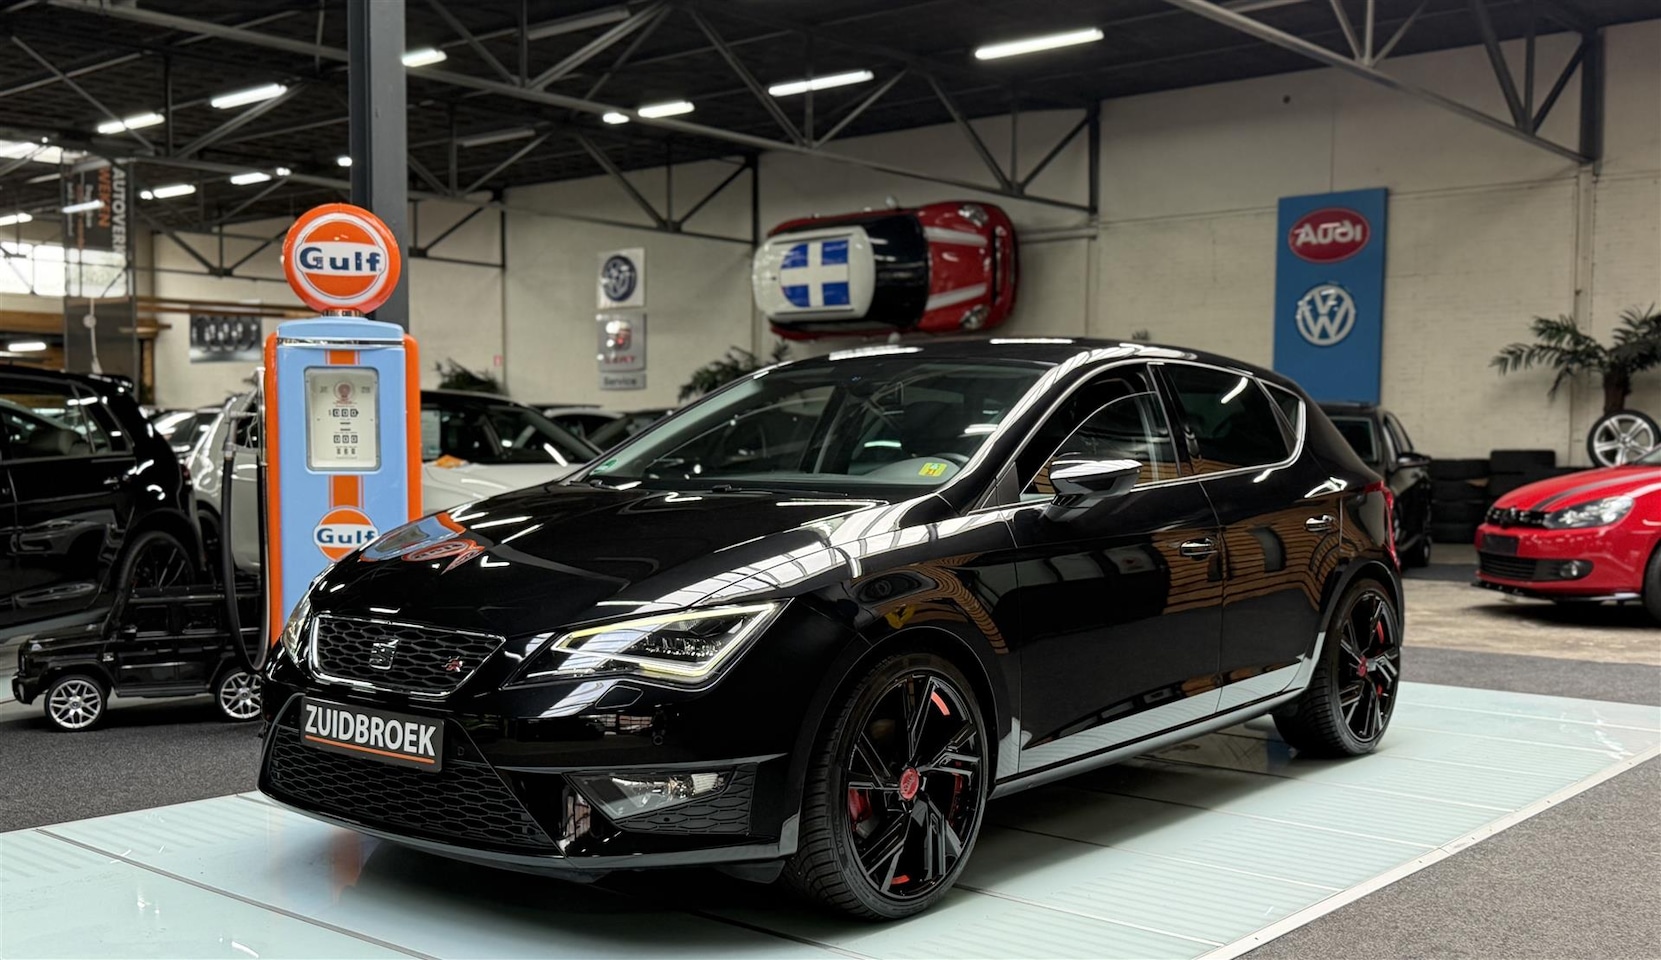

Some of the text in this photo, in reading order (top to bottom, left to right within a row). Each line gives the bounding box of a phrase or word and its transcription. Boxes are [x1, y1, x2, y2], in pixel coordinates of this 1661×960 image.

[299, 246, 380, 272] Gulf
[316, 527, 376, 544] Gulf
[305, 704, 436, 756] ZUIDBROEK
